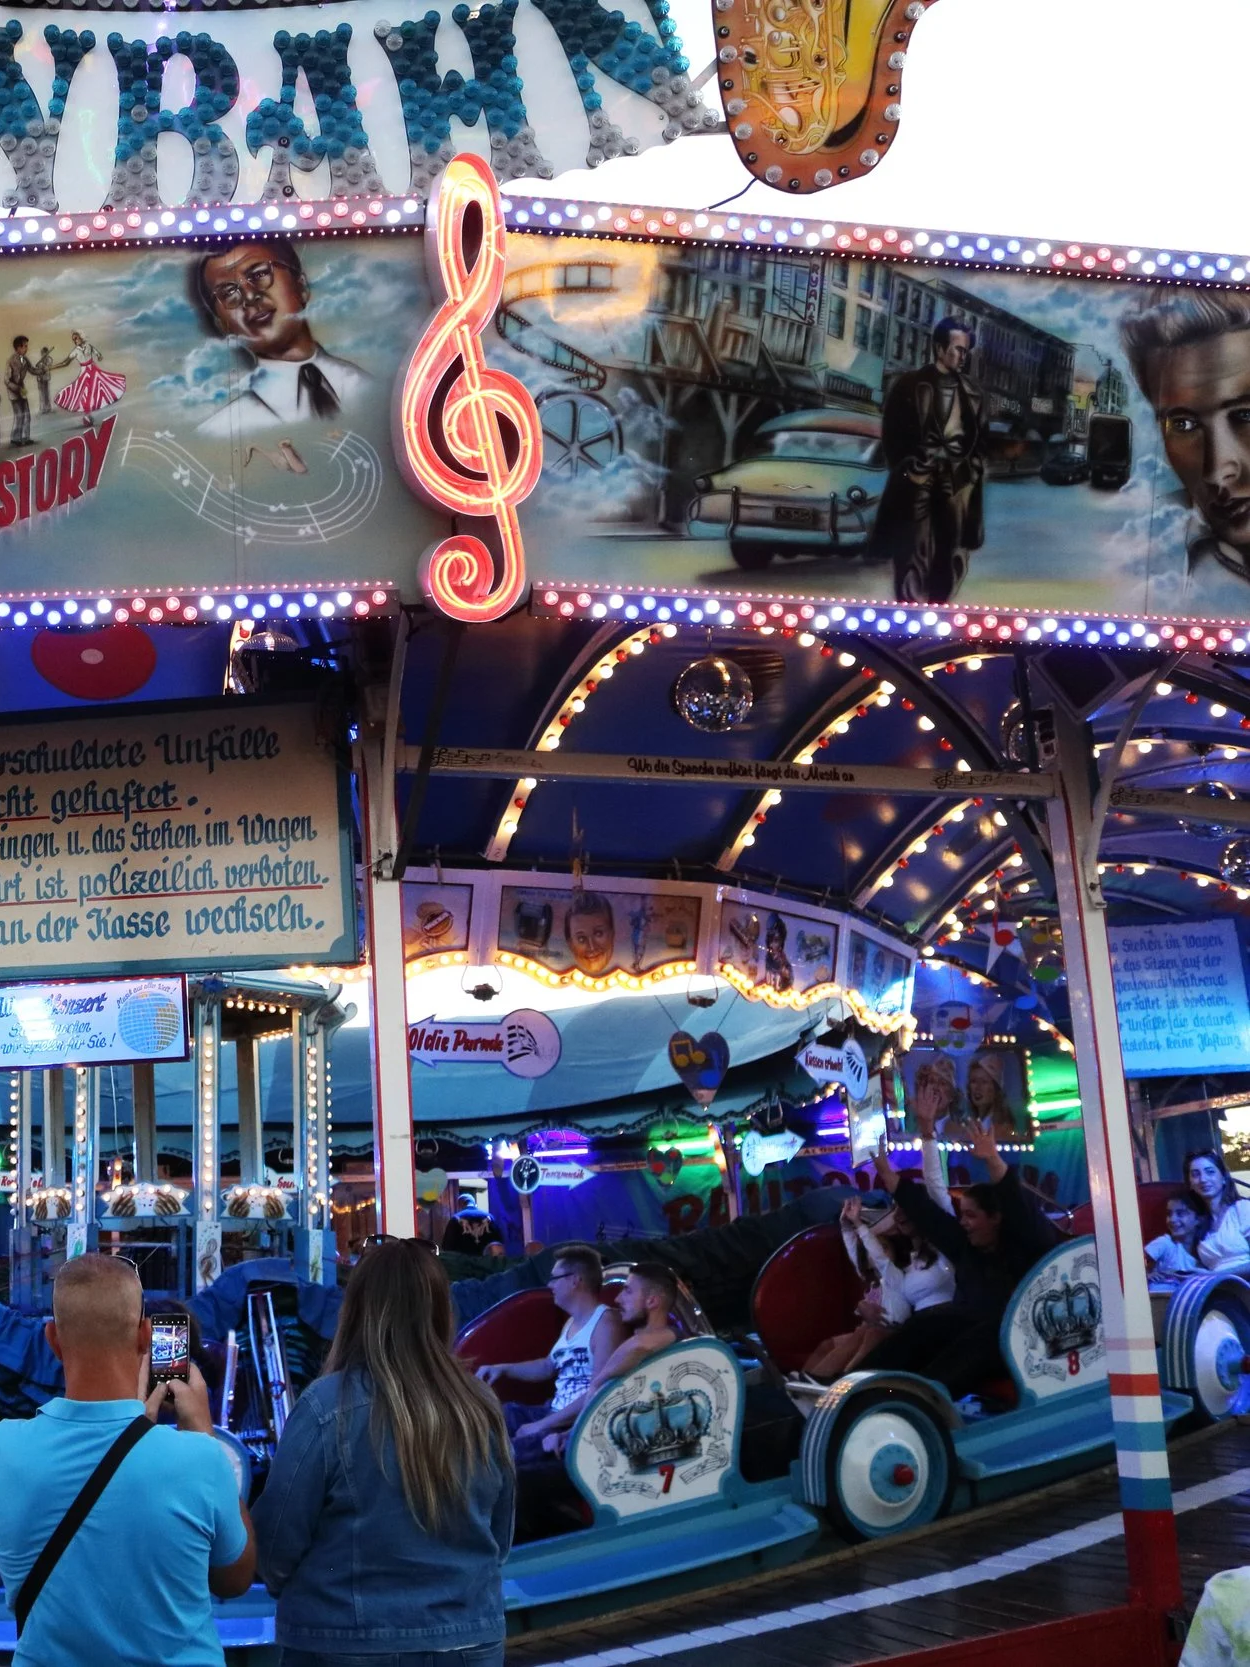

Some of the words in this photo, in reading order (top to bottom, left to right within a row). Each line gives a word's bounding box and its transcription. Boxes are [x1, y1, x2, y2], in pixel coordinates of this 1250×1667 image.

[154, 725, 281, 774] Unfälle
[627, 757, 652, 773] Wo
[653, 758, 670, 774] die
[671, 758, 715, 777] Sprache
[754, 763, 783, 781] fängt
[783, 763, 800, 780] die
[801, 764, 840, 782] Musik
[842, 771, 855, 782] an
[67, 831, 90, 856] u.
[91, 823, 126, 855] das
[130, 818, 202, 853] Stehen
[204, 807, 234, 846] im
[236, 813, 318, 854] Wagen
[35, 864, 69, 900] ist
[79, 854, 218, 908] polizeilich
[224, 853, 330, 889] verboten.
[36, 911, 80, 943] der
[85, 906, 171, 942] Kasse
[185, 894, 326, 937] wechseln.
[1182, 935, 1224, 951] Wagen
[408, 1027, 450, 1053] Oldie
[452, 1029, 505, 1053] Parade
[1067, 1350, 1082, 1375] 8
[657, 1463, 676, 1495] 7
